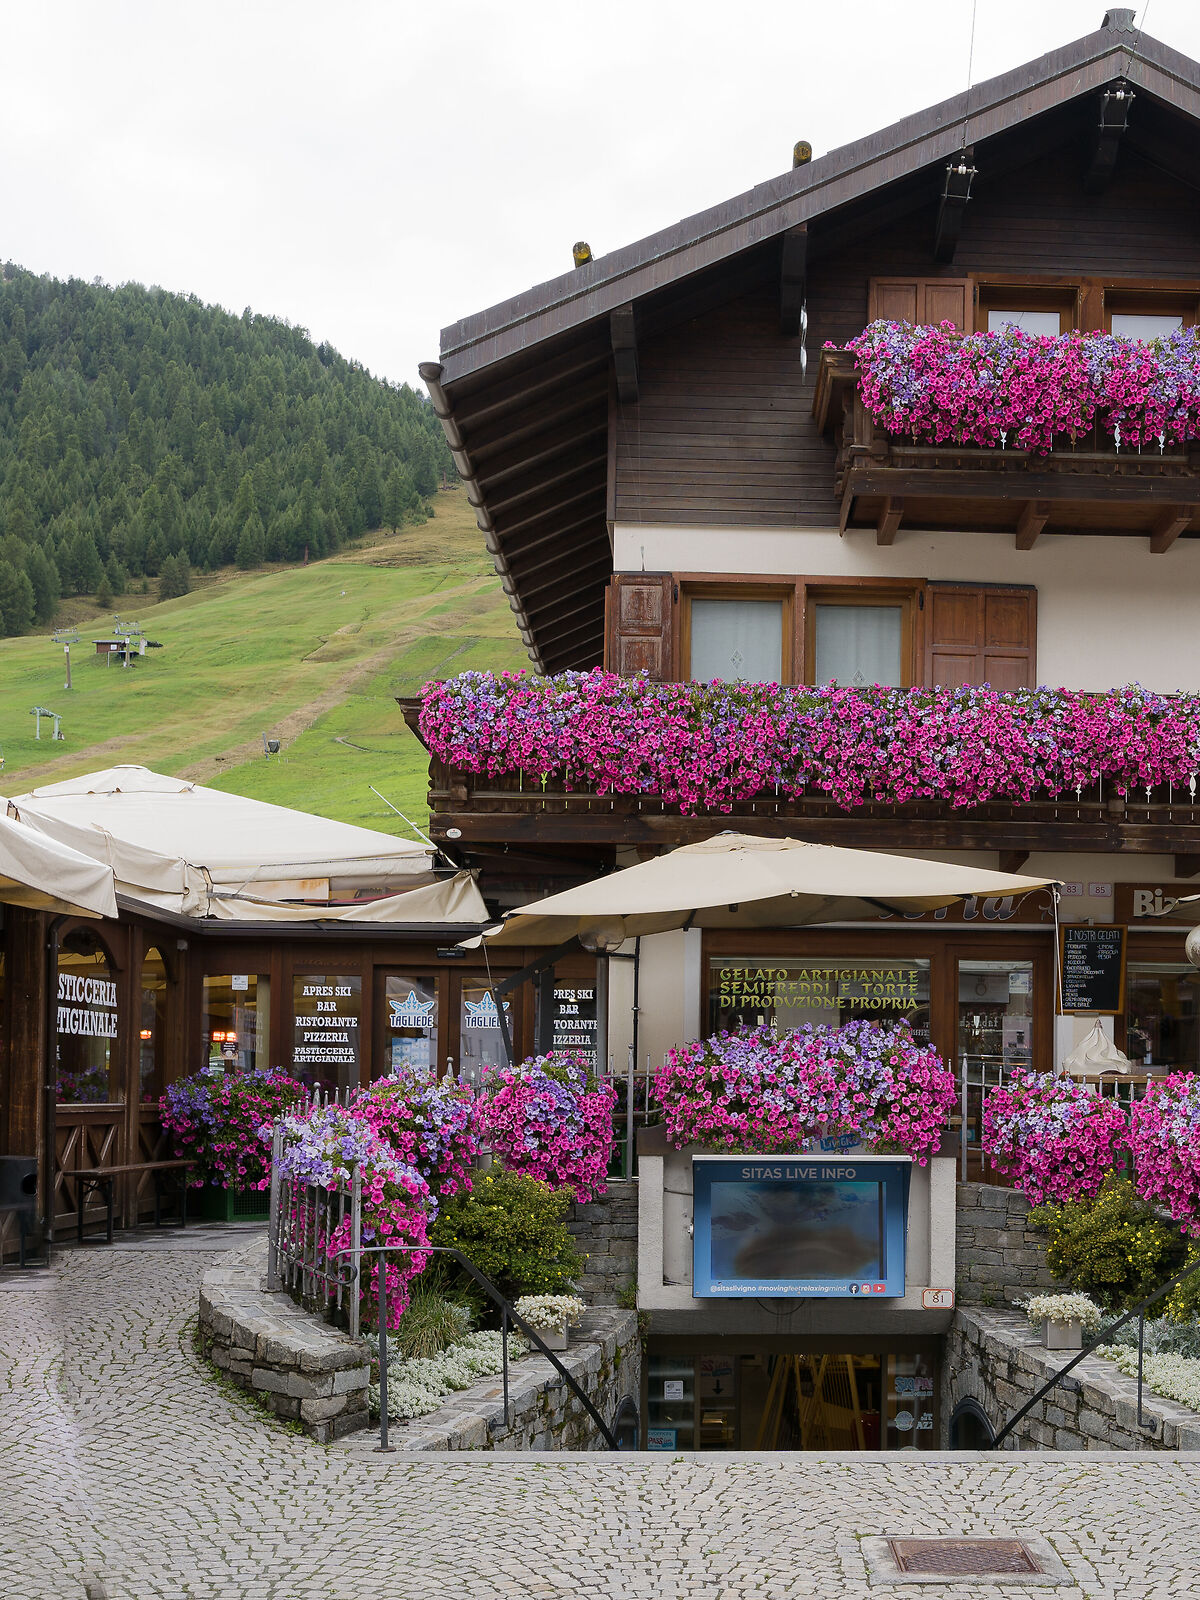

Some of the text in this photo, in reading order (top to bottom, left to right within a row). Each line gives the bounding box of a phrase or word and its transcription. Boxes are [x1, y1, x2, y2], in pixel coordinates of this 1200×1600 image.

[720, 968, 918, 982] GELATO ARTIGIANALE
[302, 986, 352, 996] APRES SKI
[720, 982, 918, 996] SEMIFREDDI E TORTE
[577, 990, 594, 999] SKI
[317, 1002, 337, 1012] BAR
[719, 996, 919, 1010] DI PRODUZIONE PROPRIA
[560, 1004, 579, 1014] BAR
[57, 1006, 118, 1038] TIGIANALE
[296, 1016, 358, 1026] RISTORANTE
[390, 1015, 433, 1027] TAGLIEDE
[466, 1015, 509, 1028] TAGLIE
[304, 1032, 349, 1042] PIZZERIA
[742, 1168, 856, 1178] SITAS LIVE INFO
[932, 1295, 944, 1303] 81
